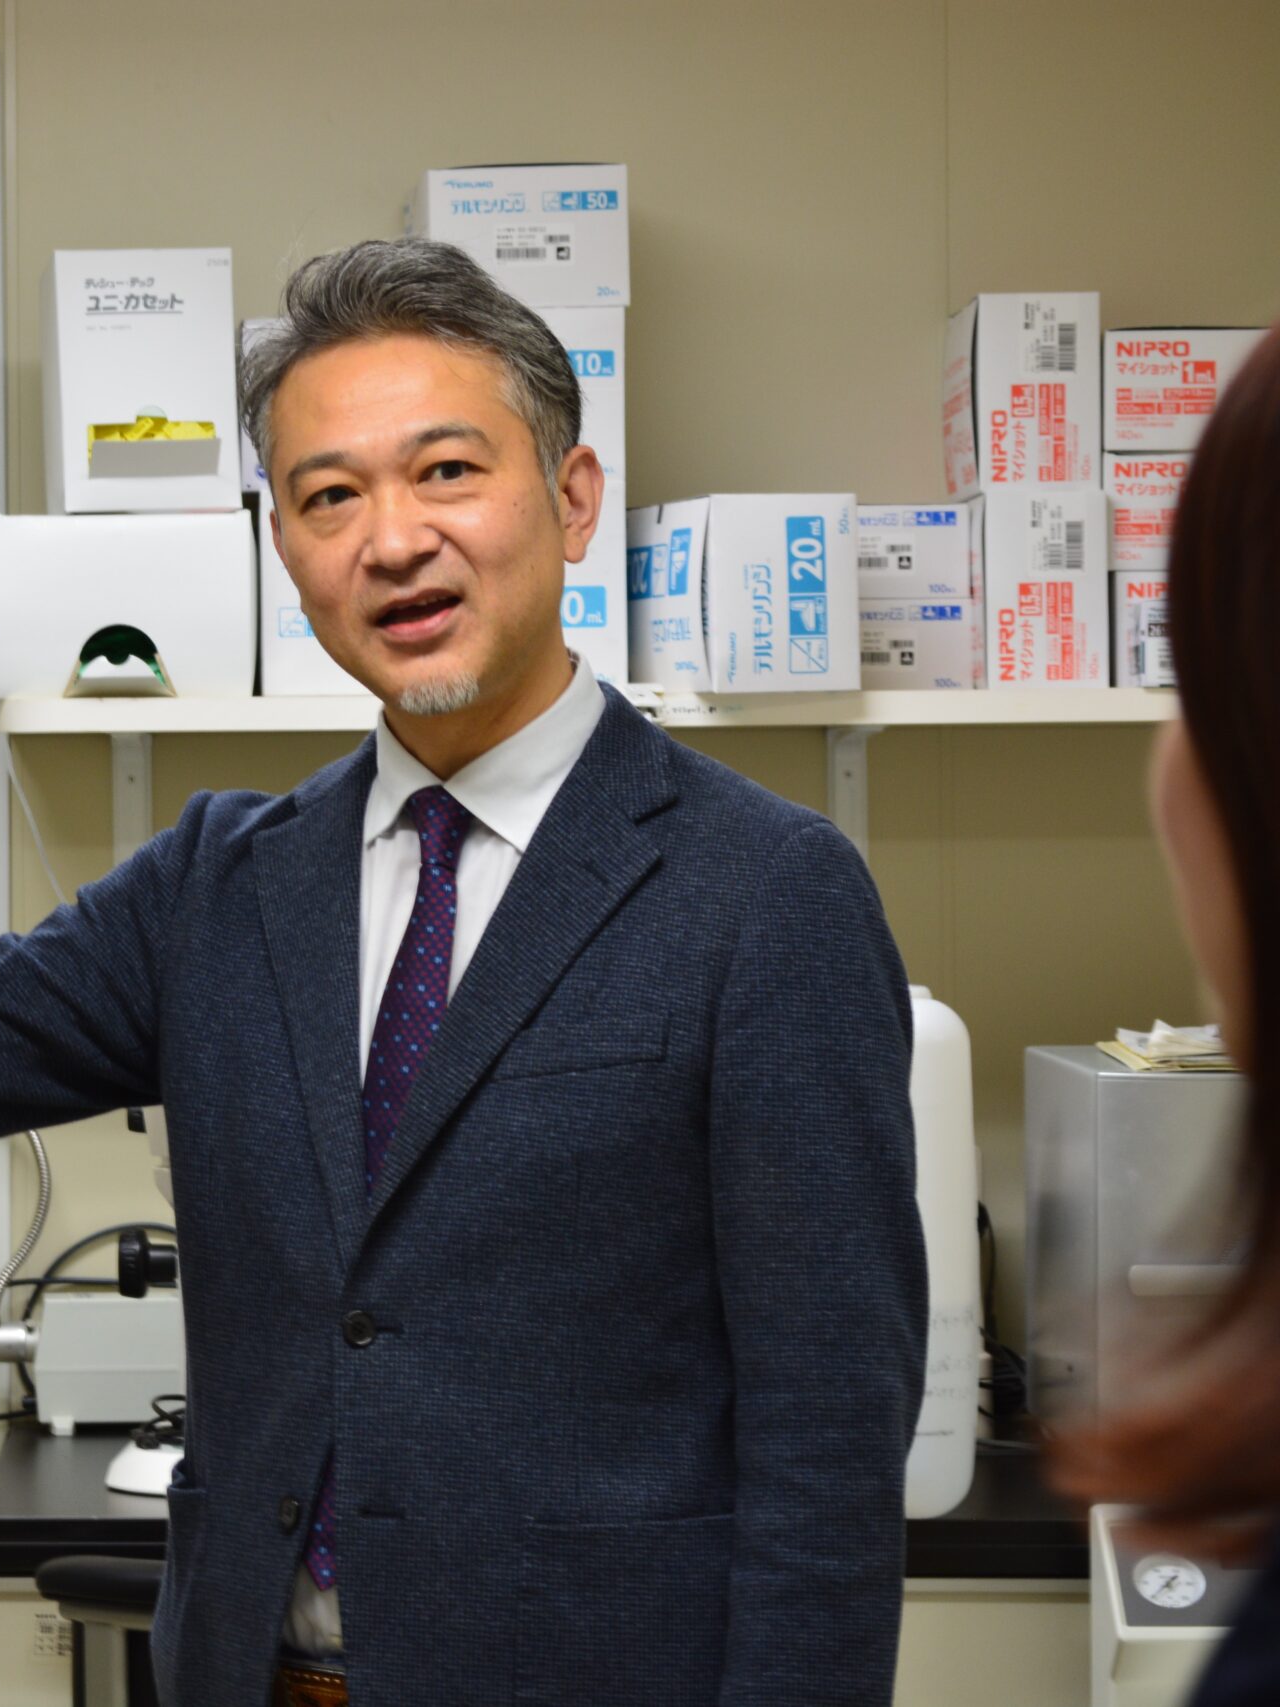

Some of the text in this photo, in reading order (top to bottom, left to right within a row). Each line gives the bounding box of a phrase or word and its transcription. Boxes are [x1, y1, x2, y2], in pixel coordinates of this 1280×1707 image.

[1116, 341, 1190, 358] NIPRO
[991, 410, 1008, 482] NIPRO
[1114, 462, 1188, 478] NIPRO
[1126, 582, 1169, 598] NIP
[754, 563, 774, 675] テルモシリンジ
[998, 609, 1015, 682] NIPRO
